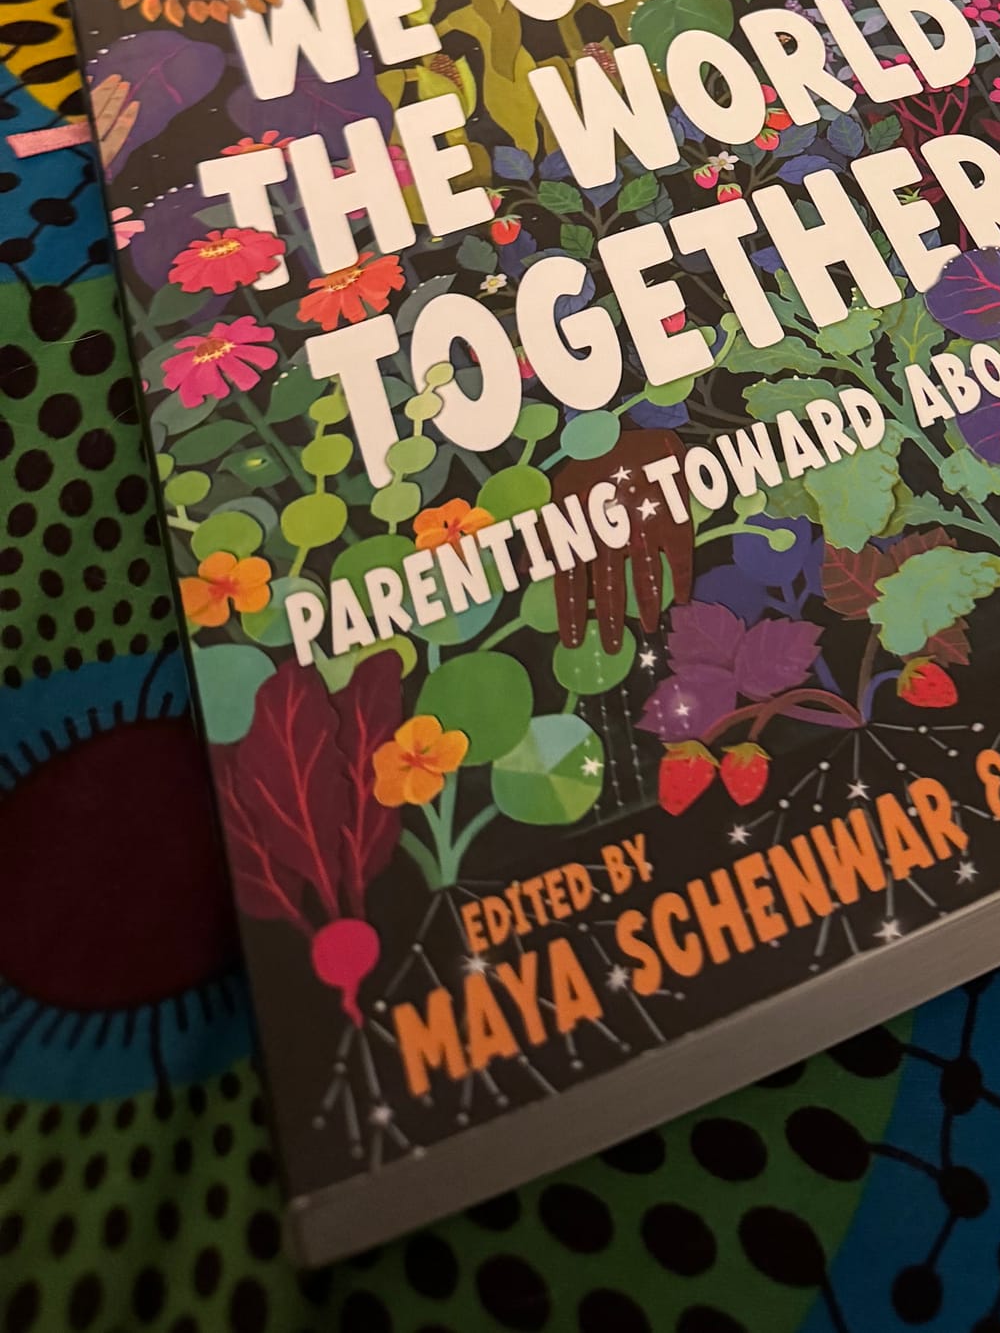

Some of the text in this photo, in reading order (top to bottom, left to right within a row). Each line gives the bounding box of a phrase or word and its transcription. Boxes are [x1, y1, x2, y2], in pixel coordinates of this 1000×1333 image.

[199, 93, 496, 291] THE
[284, 480, 632, 667] PARENTING
[647, 385, 888, 527] TOWARD
[394, 941, 603, 1098] MAYA
[614, 775, 970, 998] SCHENWAR
[461, 832, 655, 957] EDITED BY
